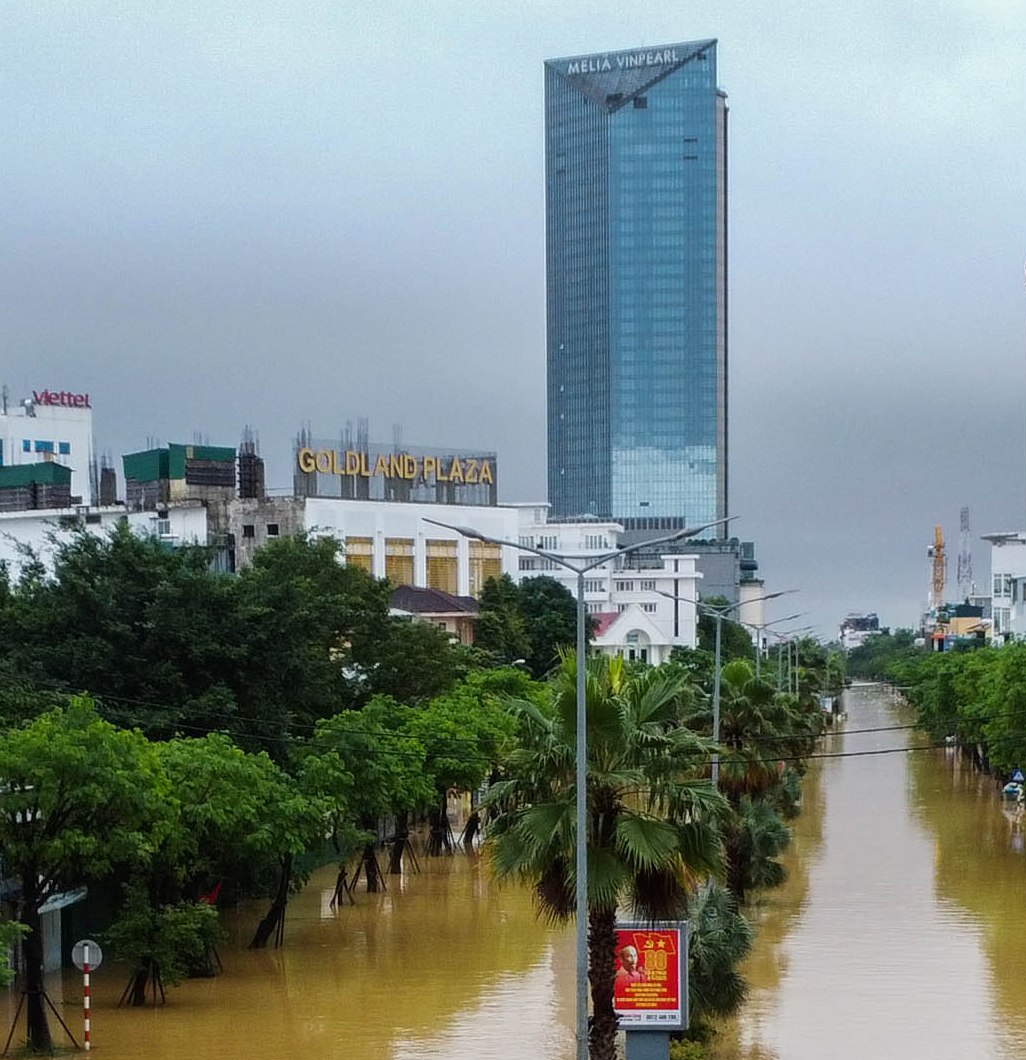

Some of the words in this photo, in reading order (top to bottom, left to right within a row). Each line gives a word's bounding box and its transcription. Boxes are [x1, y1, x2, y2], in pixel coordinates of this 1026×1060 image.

[616, 50, 679, 68] VINPEARL
[299, 447, 418, 480] GOLDLAND
[423, 456, 494, 484] PLAZA
